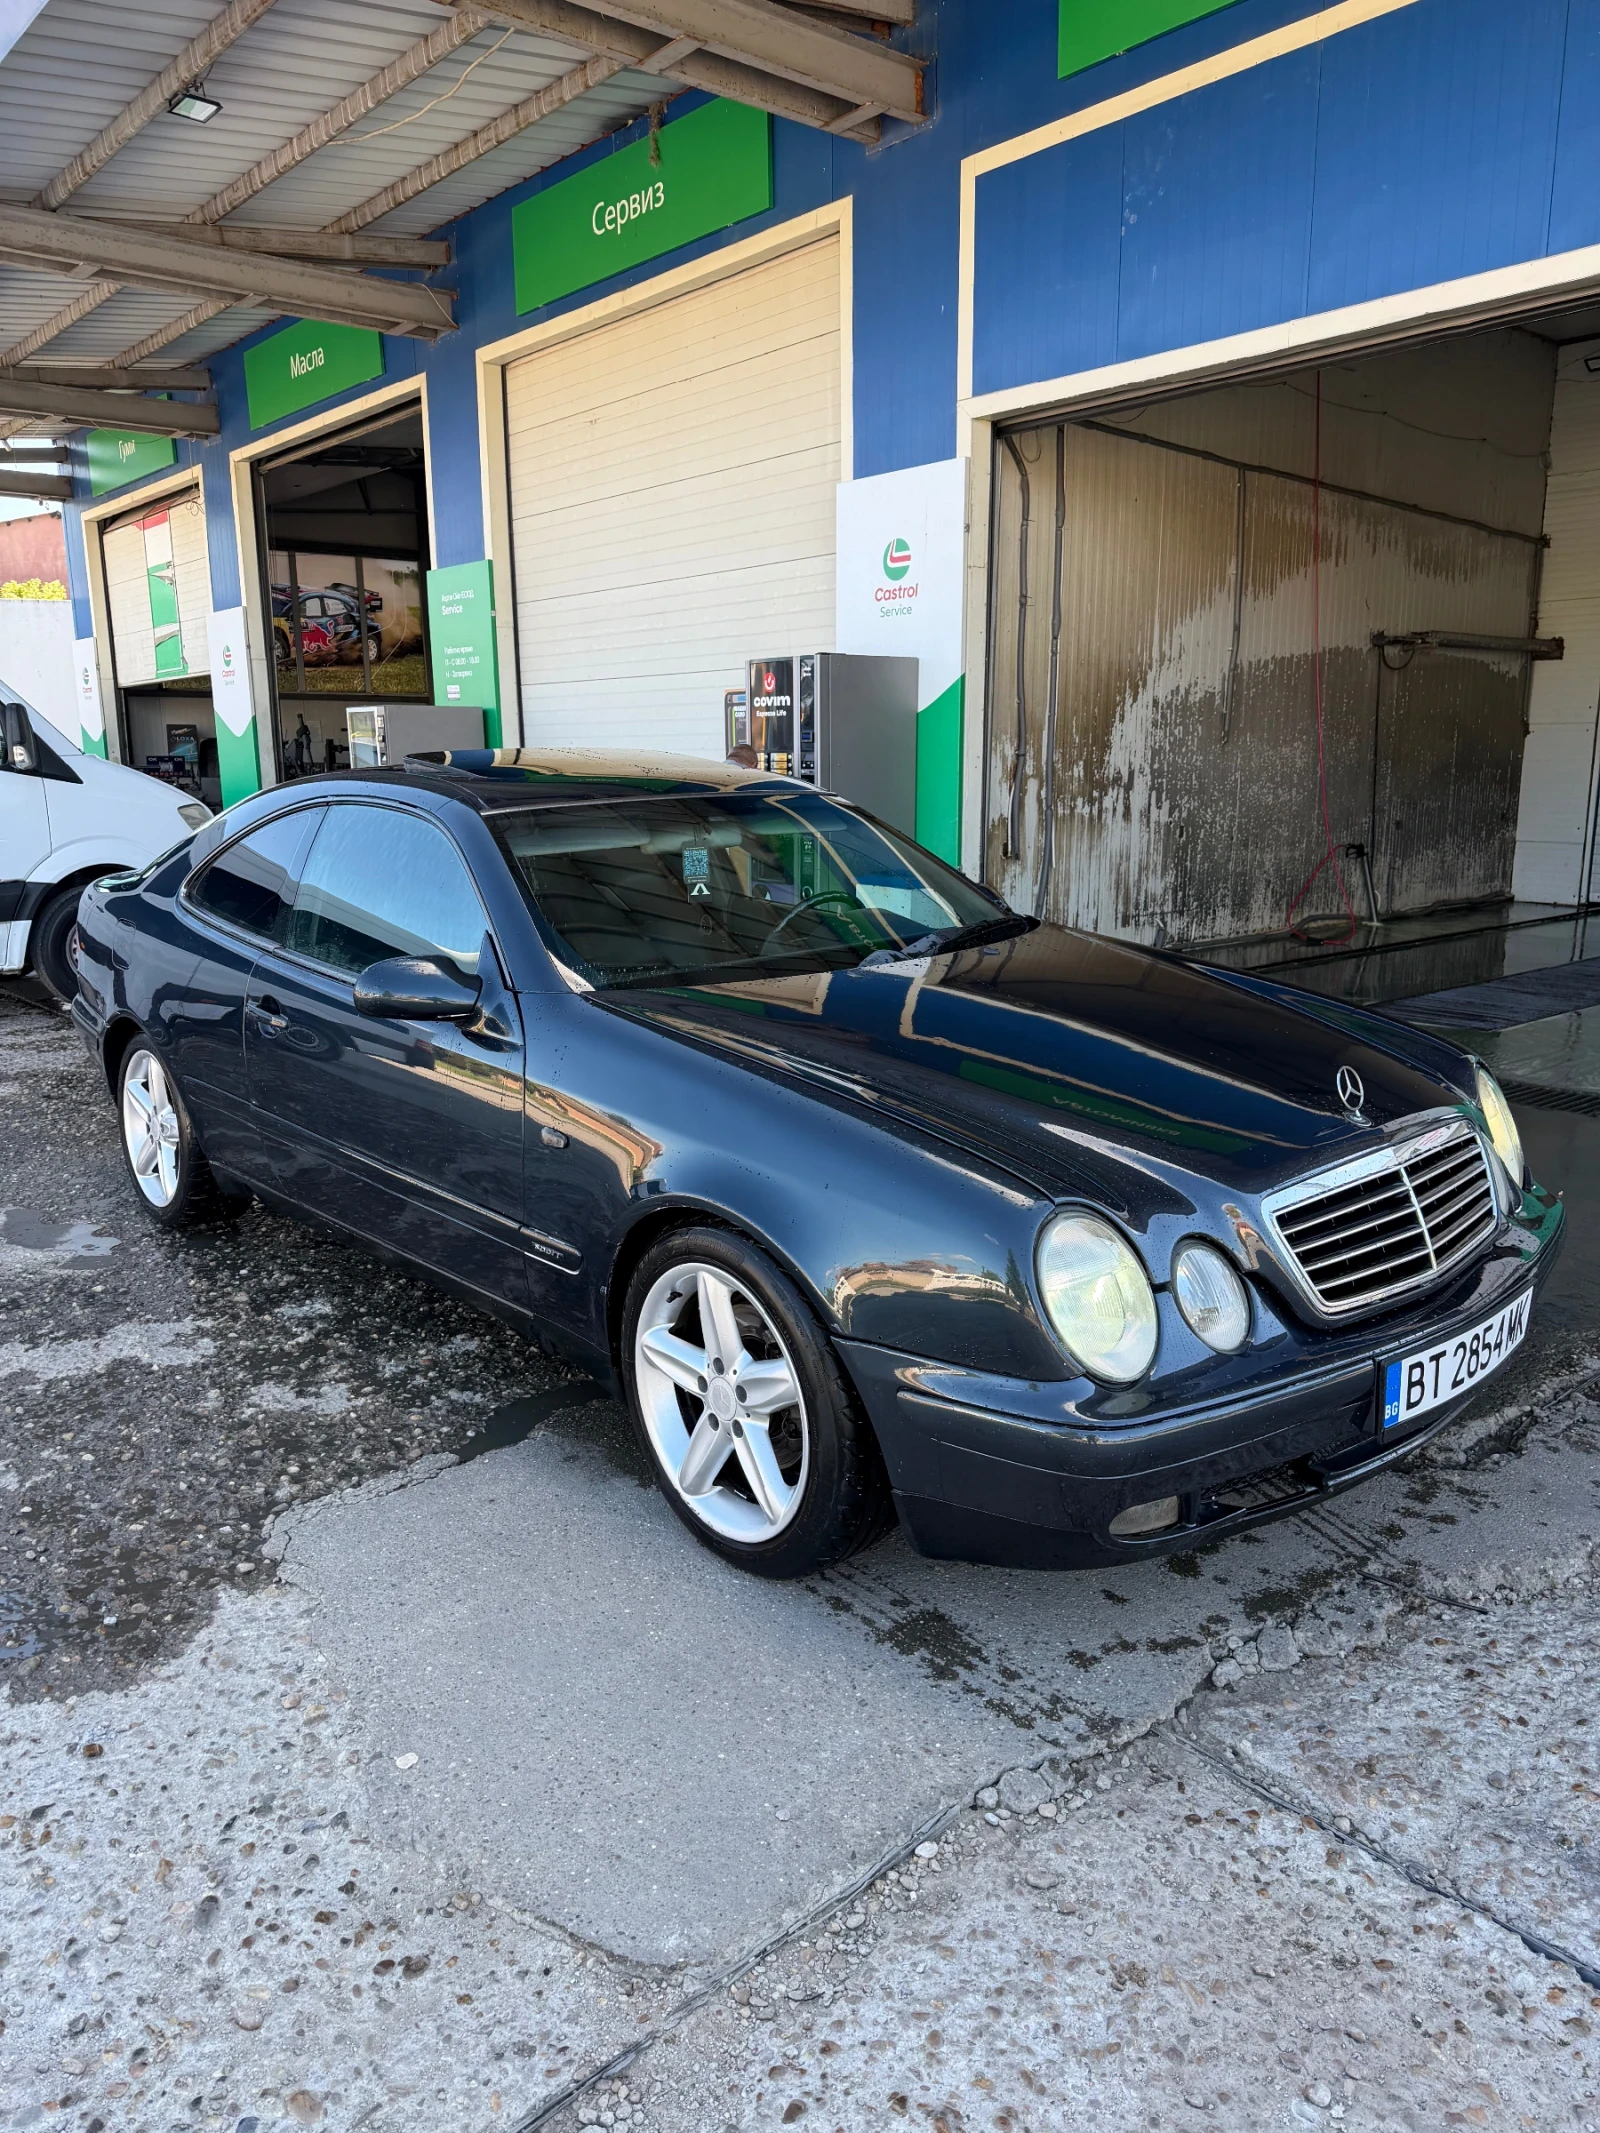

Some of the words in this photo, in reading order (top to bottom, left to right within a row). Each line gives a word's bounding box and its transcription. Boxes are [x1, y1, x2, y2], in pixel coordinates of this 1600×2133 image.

[592, 181, 665, 236] Сервиз
[290, 347, 325, 380] Масла
[874, 582, 919, 602] Castrol
[879, 603, 913, 618] Service
[753, 695, 791, 707] covim
[776, 709, 787, 717] Life
[1384, 1401, 1400, 1420] BG
[1405, 1350, 1447, 1411] BT
[1451, 1314, 1506, 1391] 2854
